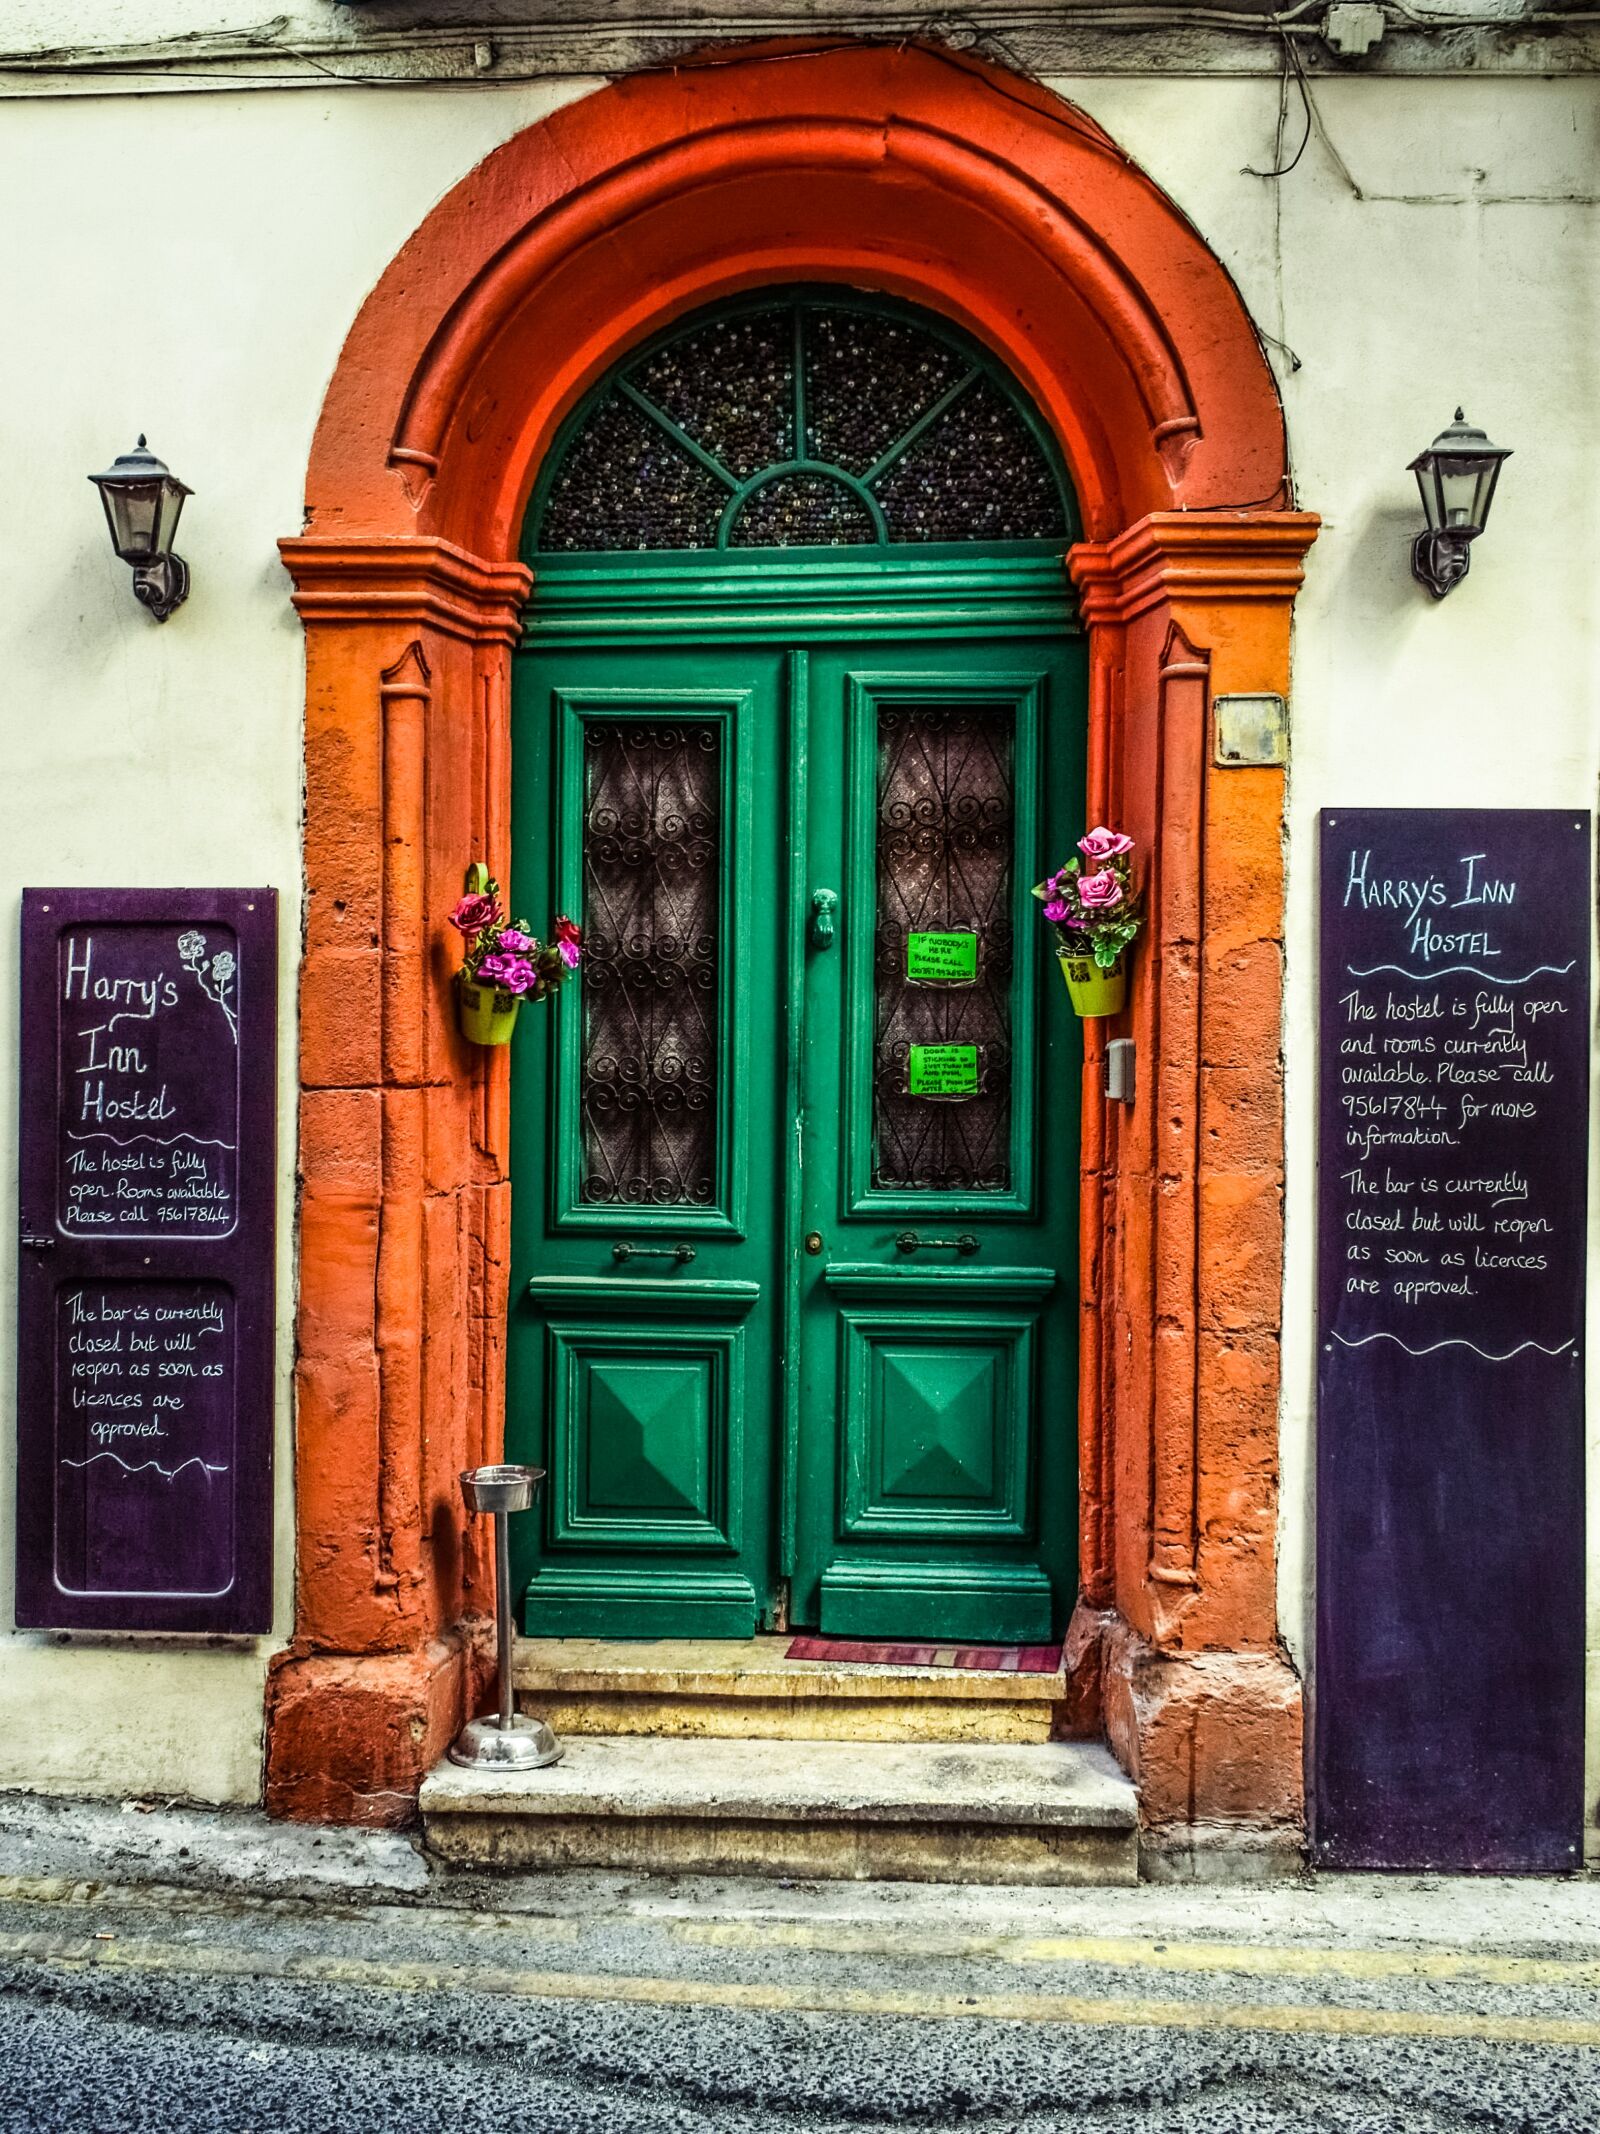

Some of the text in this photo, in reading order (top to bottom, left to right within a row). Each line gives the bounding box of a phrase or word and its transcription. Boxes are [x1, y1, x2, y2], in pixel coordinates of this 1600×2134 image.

[1344, 850, 1516, 929] HARRY'S INN
[918, 936, 927, 944] IF
[1411, 918, 1501, 961] HOSTEL
[914, 954, 965, 967] PLEASE CALL
[65, 937, 178, 1032] Harry's
[1339, 990, 1568, 1036] The hostel is fully open
[76, 1025, 147, 1073] Inn
[1340, 1033, 1527, 1068] and rooms currently
[1342, 1061, 1554, 1083] available. Please call
[81, 1080, 177, 1122] Hostel
[1342, 1093, 1536, 1130] 95617844 for more
[1346, 1124, 1461, 1161] information.
[66, 1150, 207, 1182] The hostel is fully
[69, 1178, 230, 1202] open. Rooms available
[1340, 1167, 1528, 1207] The bar is currently
[66, 1206, 229, 1224] Please call 95617844
[1346, 1207, 1554, 1243] closed but will reopen
[1347, 1245, 1548, 1270] as soon as licences
[1346, 1275, 1479, 1305] are approved.
[65, 1290, 224, 1337] The bar is currently
[69, 1329, 197, 1353] closed but will
[72, 1363, 224, 1385] reopen as soon as
[152, 1395, 185, 1410] are
[90, 1414, 169, 1444] approved.
